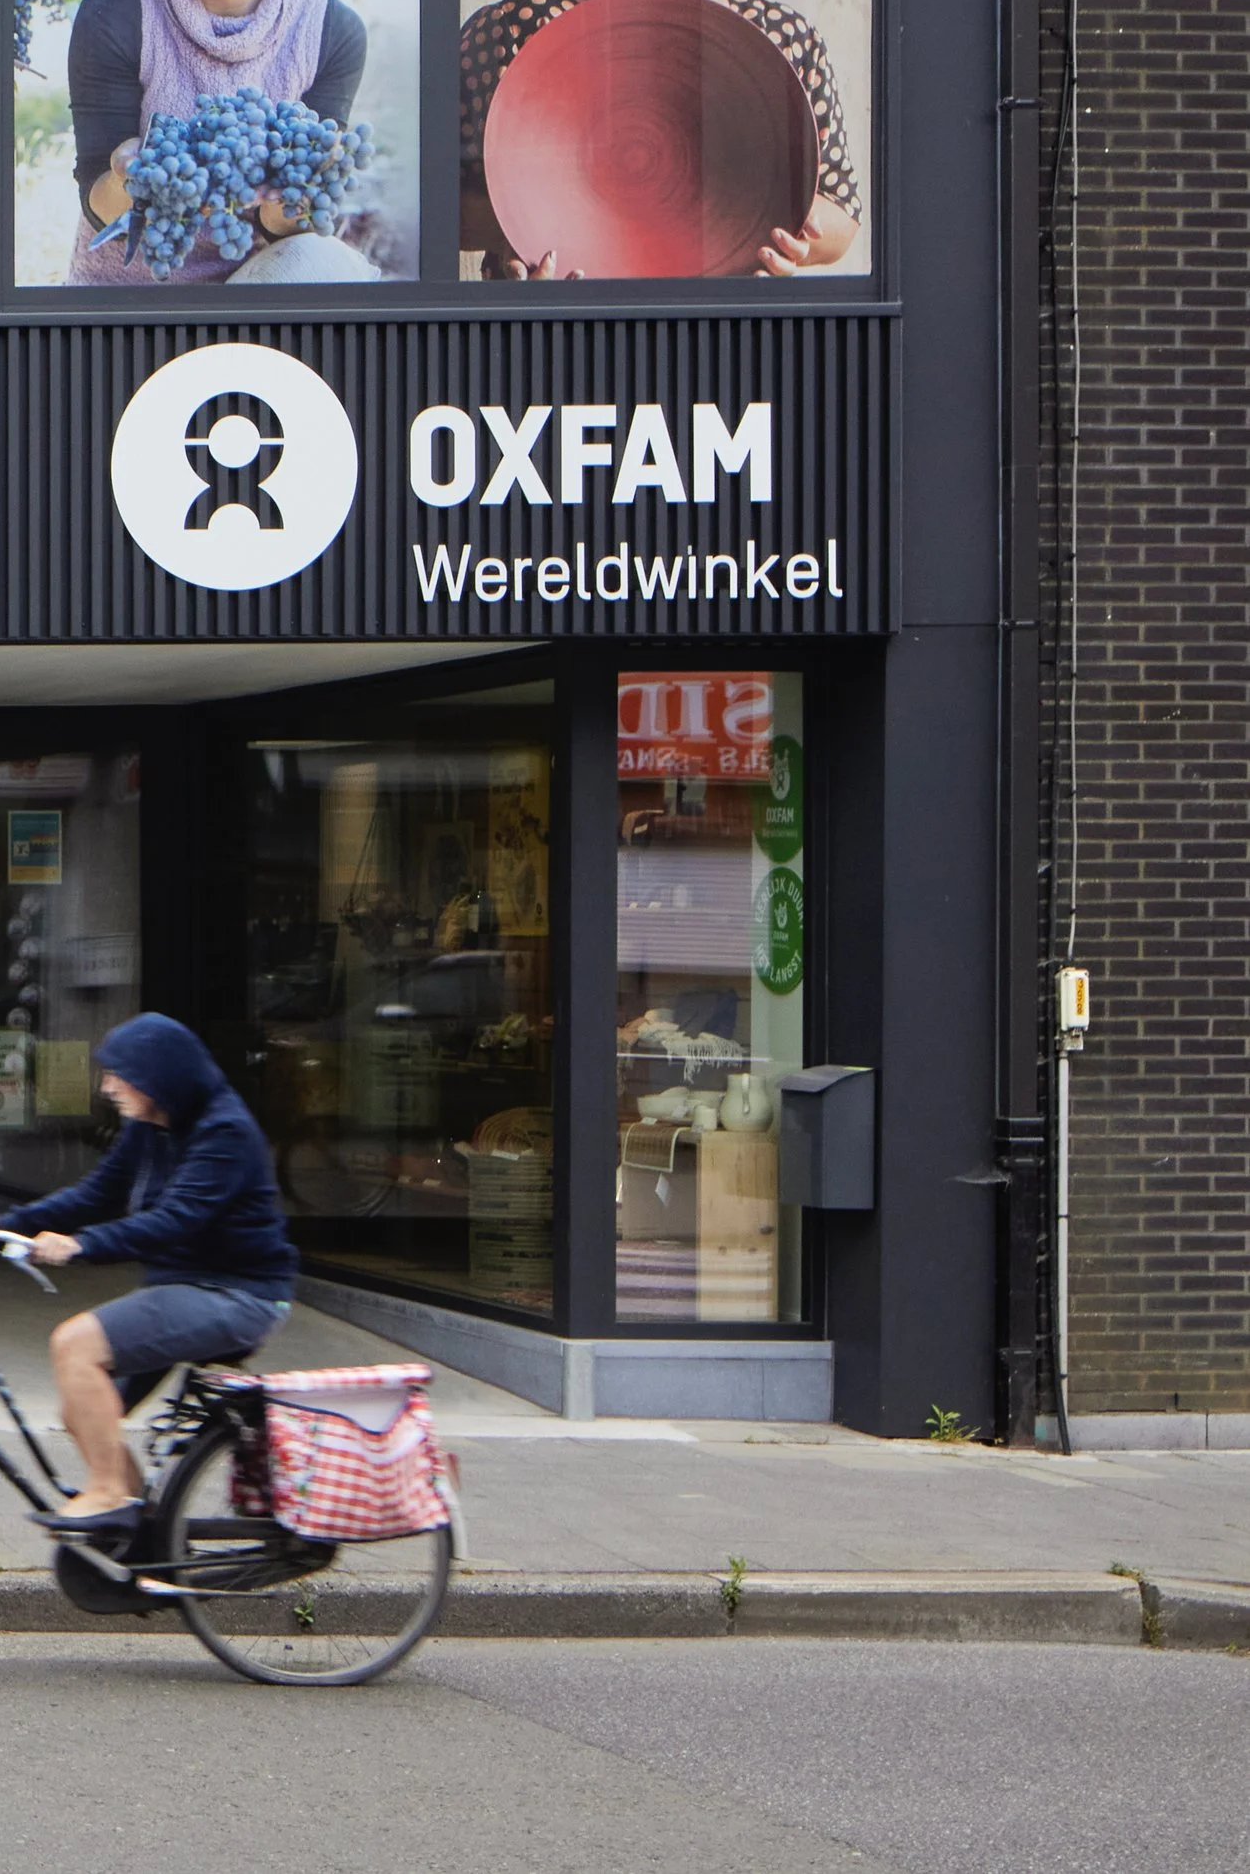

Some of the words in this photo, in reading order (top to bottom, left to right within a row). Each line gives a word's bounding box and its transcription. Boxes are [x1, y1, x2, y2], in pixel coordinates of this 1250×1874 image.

[410, 402, 772, 508] OXFAM
[413, 538, 844, 603] Wereldwinkel
[766, 807, 794, 823] OXFAM
[770, 949, 802, 984] LANGST
